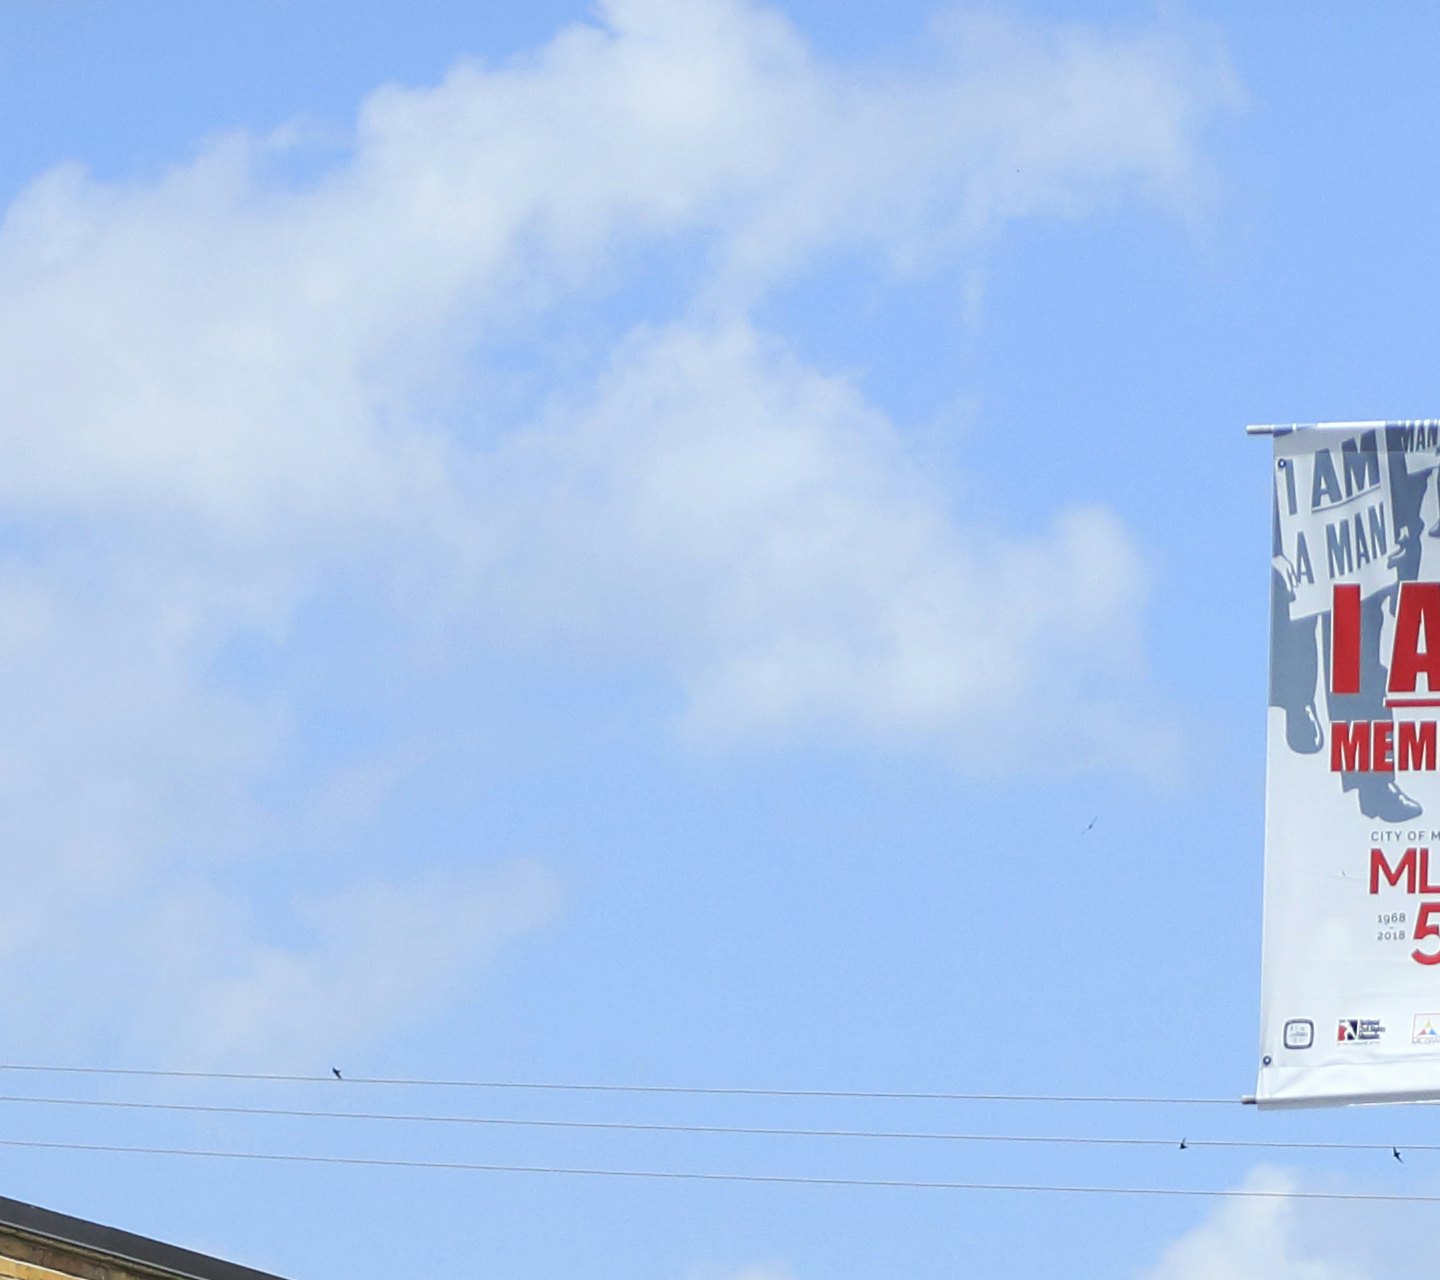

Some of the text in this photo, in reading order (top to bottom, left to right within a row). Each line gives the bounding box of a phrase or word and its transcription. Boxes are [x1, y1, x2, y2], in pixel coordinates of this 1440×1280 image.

[1285, 428, 1381, 516] I AM
[1296, 501, 1388, 585] A MAN
[1331, 583, 1361, 695] I
[1370, 830, 1402, 842] CITY
[1407, 830, 1426, 841] OF
[1377, 912, 1406, 925] 1968
[1377, 930, 1406, 941] 2018
